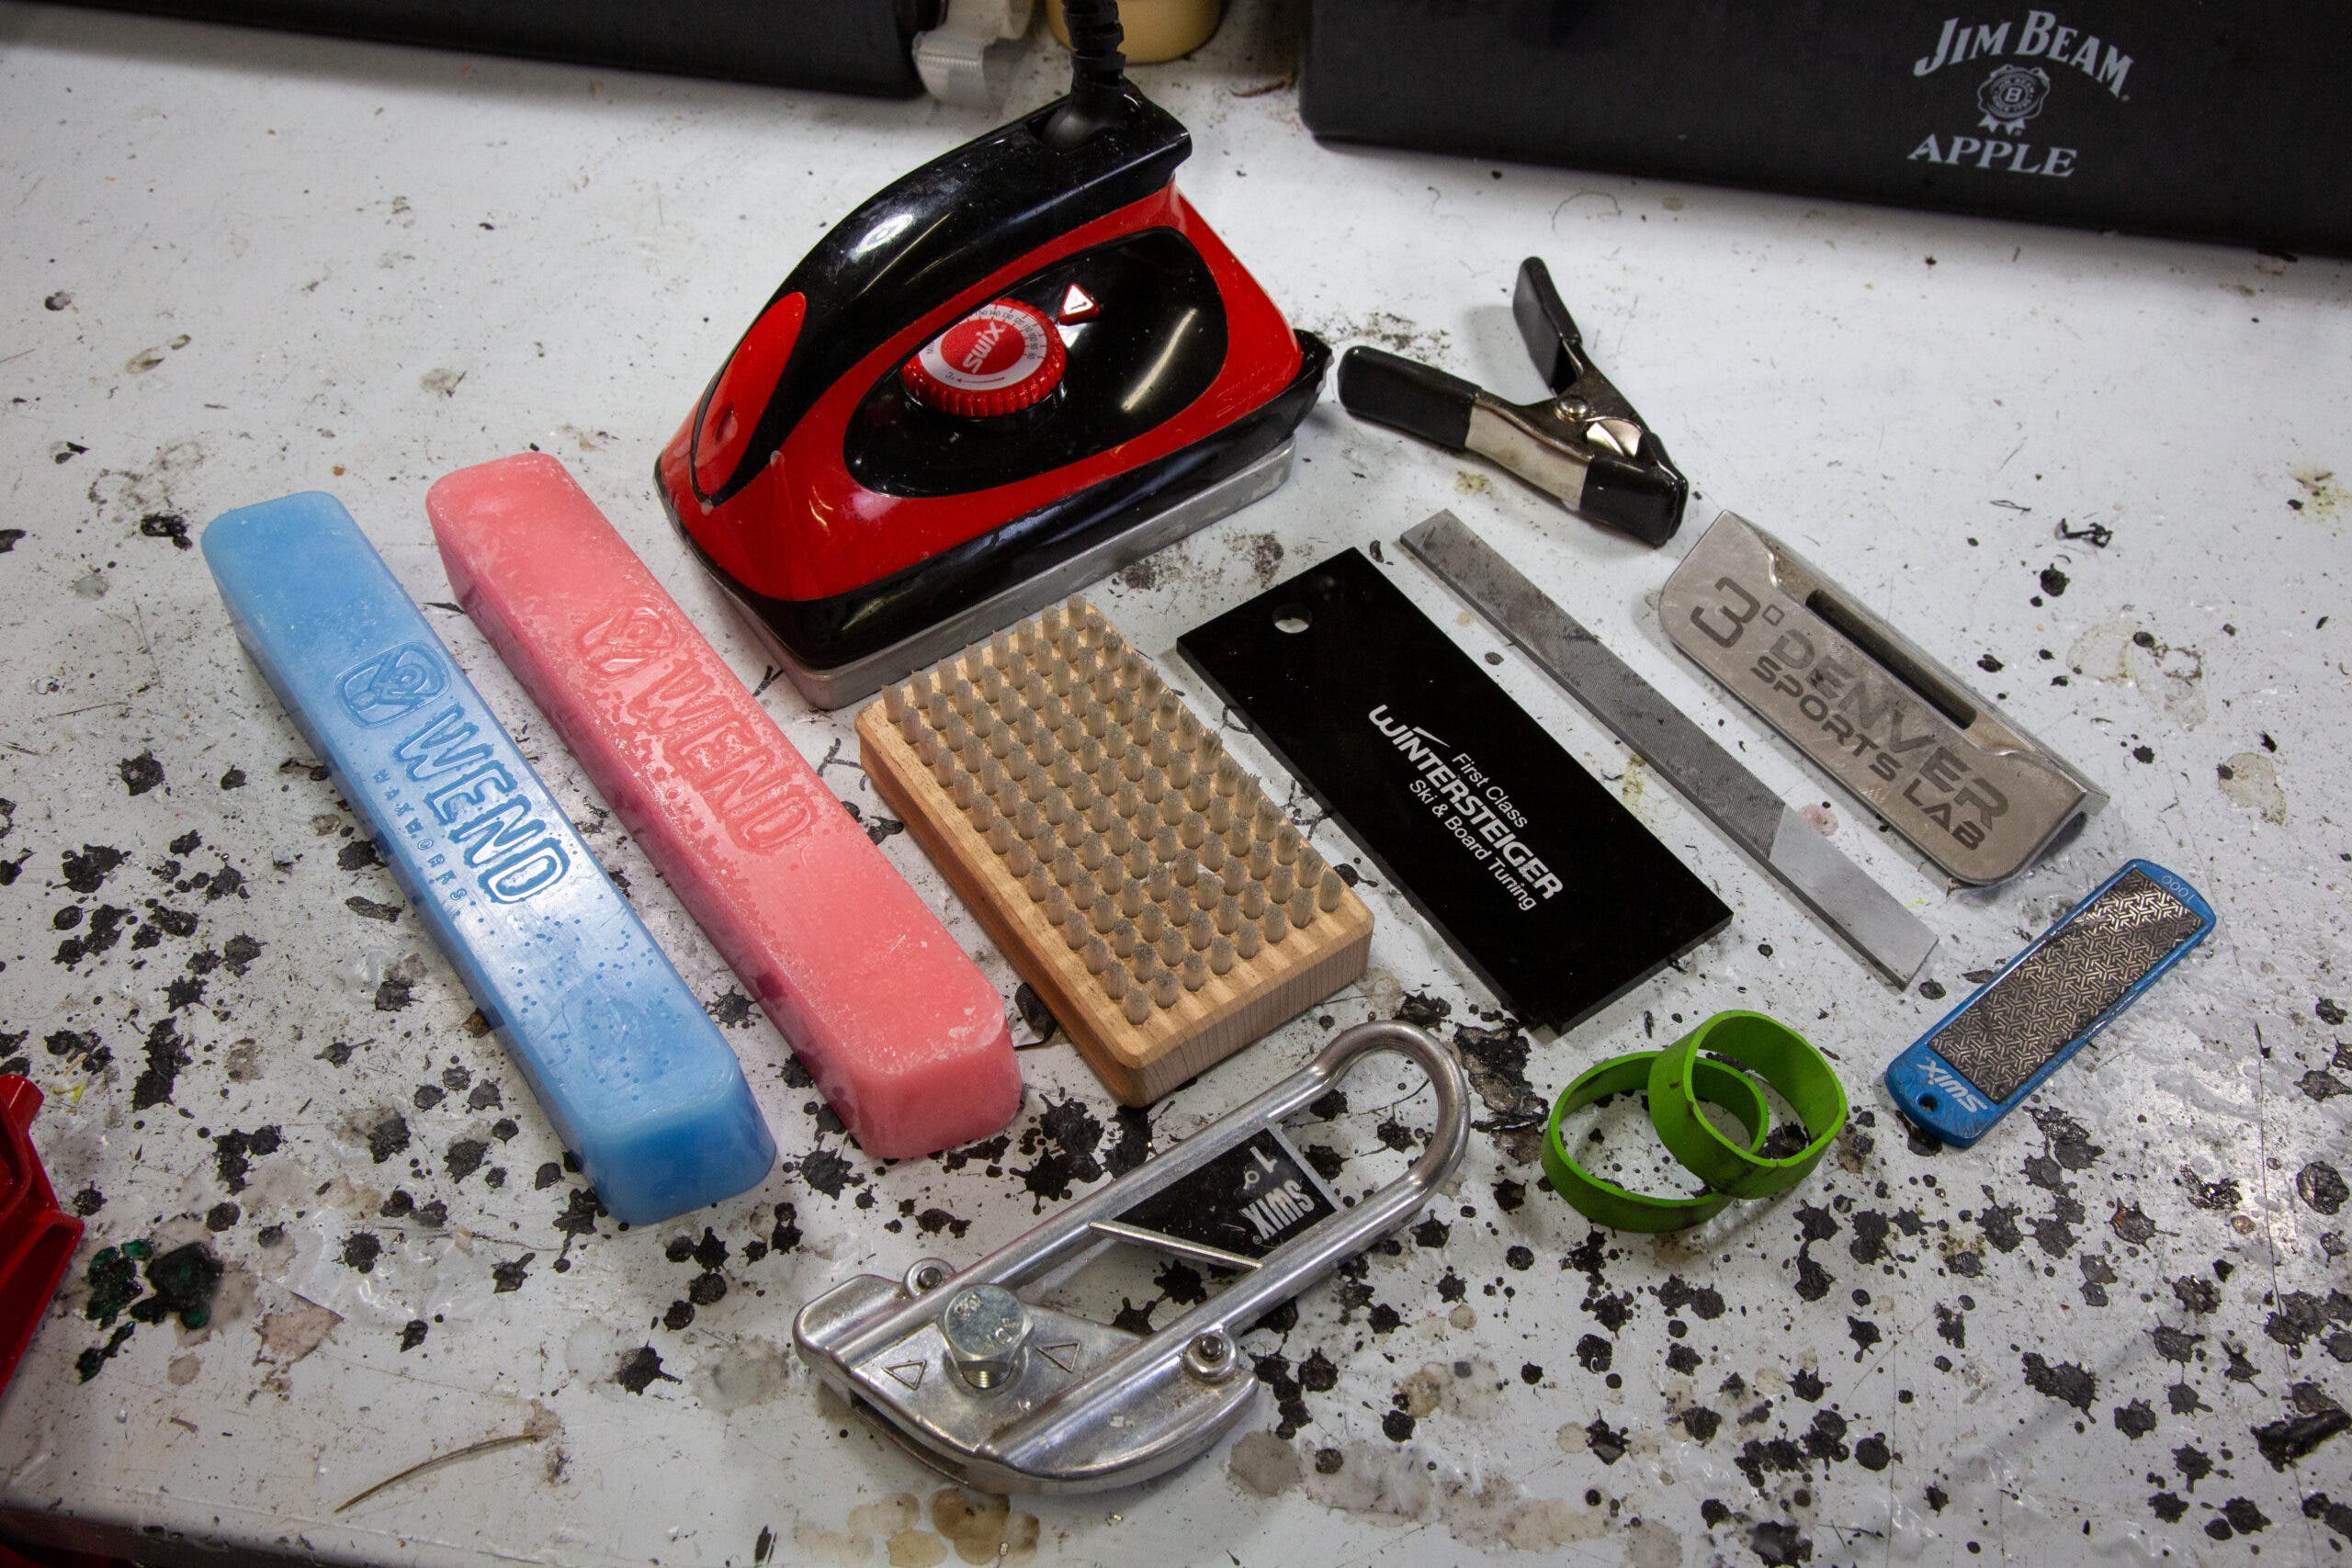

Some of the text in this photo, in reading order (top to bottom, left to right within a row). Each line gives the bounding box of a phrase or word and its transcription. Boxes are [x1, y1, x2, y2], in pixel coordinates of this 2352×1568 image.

[1912, 9, 2134, 99] JIM BEAM
[1906, 133, 2078, 178] APPLE
[1750, 654, 1904, 783] SPORTS
[1769, 628, 2009, 831] DENVER
[392, 703, 570, 905] WEND
[1368, 704, 1564, 900] WINTERSTEIGER
[1409, 779, 1538, 911] Ski & Board Tuning
[1452, 752, 1529, 828] First Class
[1903, 778, 1986, 851] LAB
